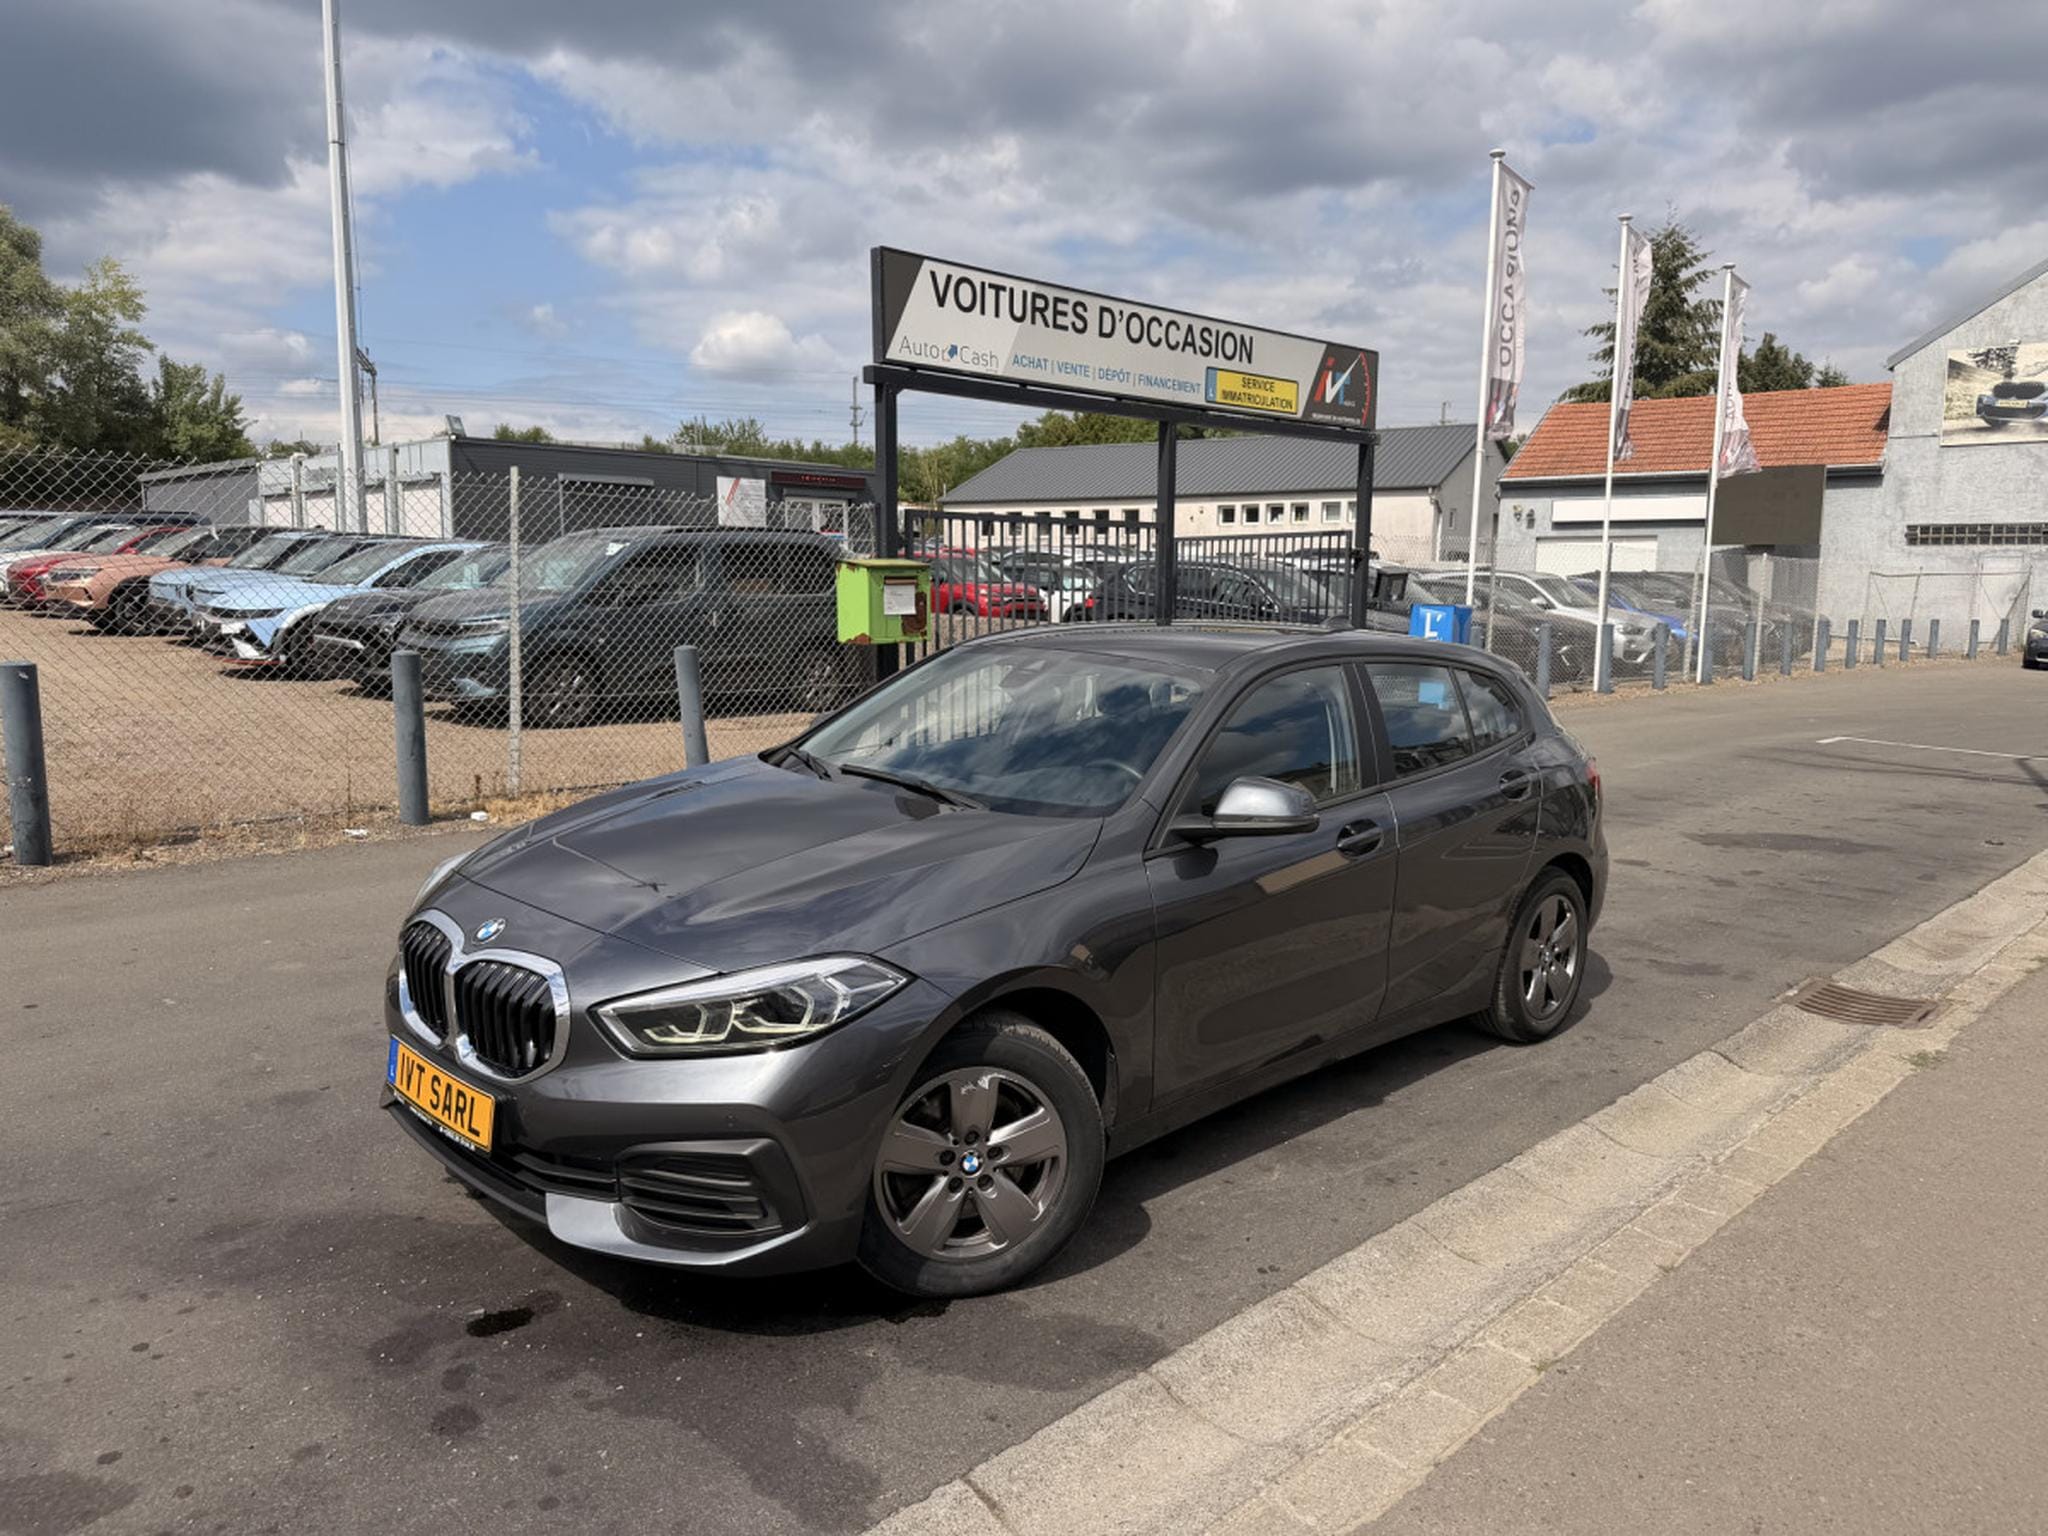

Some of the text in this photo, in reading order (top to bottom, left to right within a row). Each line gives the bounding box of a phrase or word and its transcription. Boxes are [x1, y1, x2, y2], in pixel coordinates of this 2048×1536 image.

[930, 270, 1254, 364] VOITURES D'OCCASION
[960, 345, 999, 369] Cash
[1012, 354, 1048, 372] ACHAT
[1057, 361, 1090, 378] VENTE
[1138, 373, 1201, 394] FINANCEMENT
[1241, 376, 1275, 393] SERVICE
[401, 1052, 425, 1100] IVT
[429, 1074, 480, 1137] SARL
